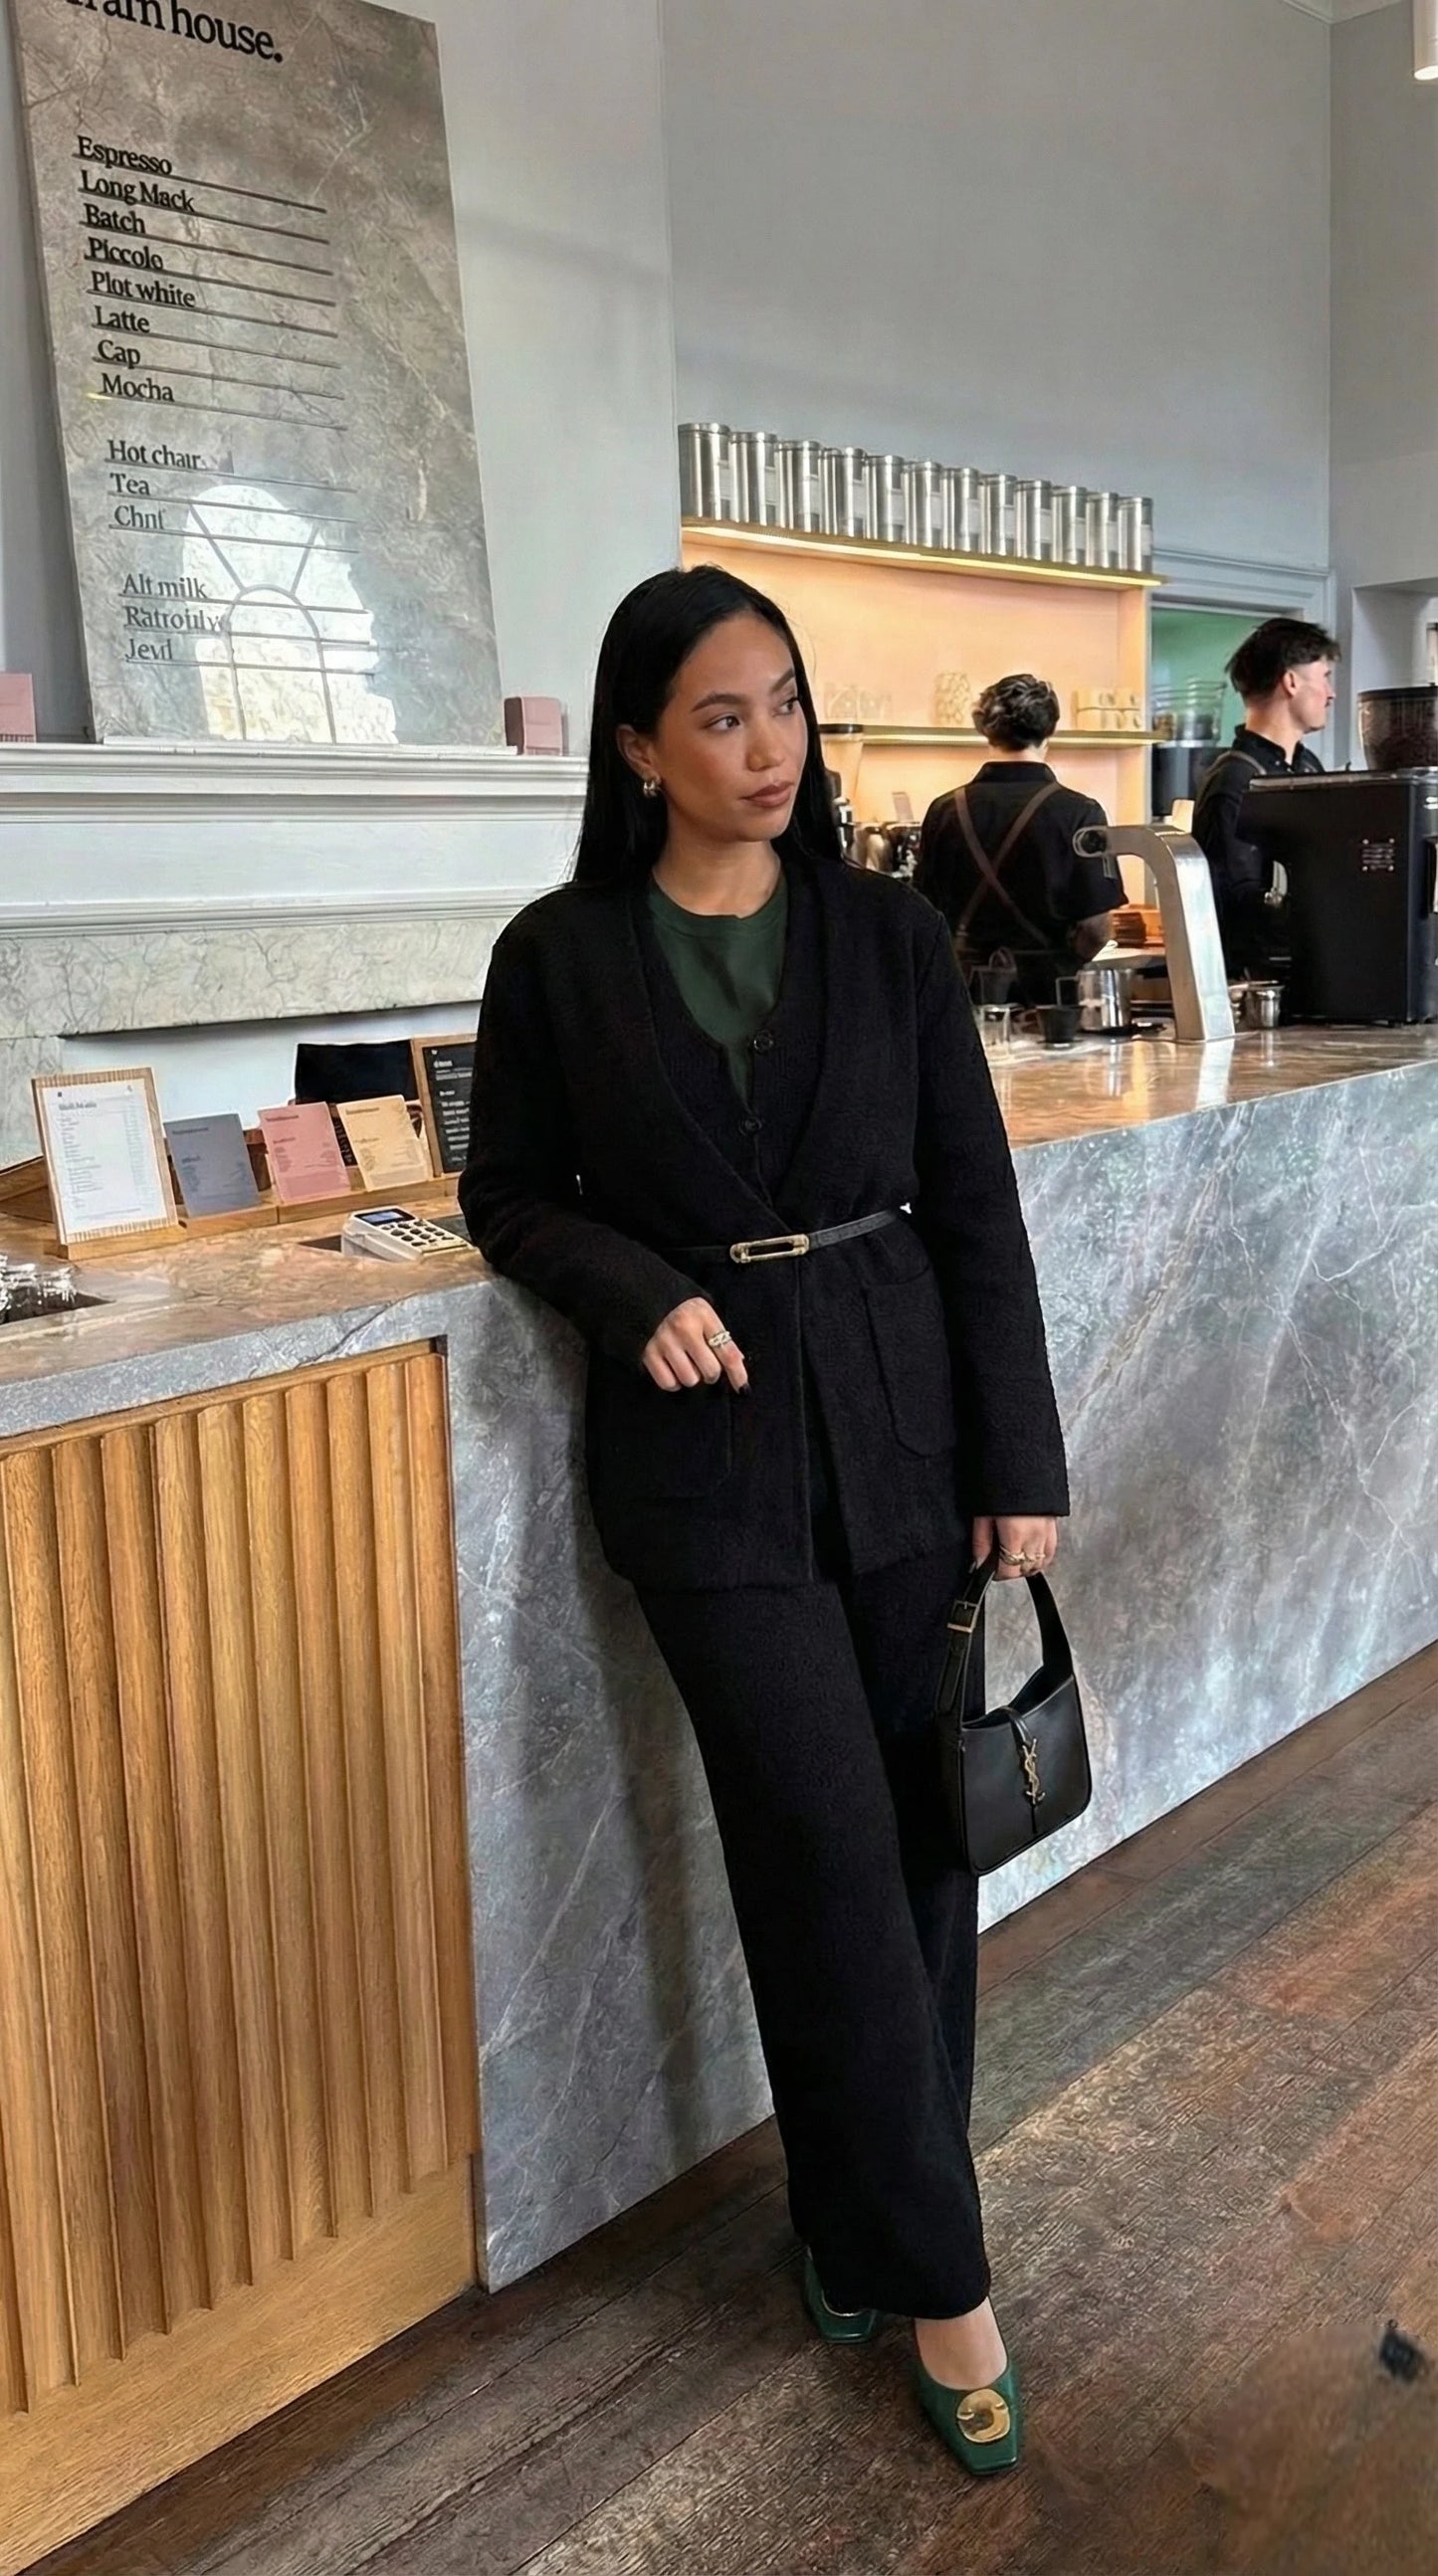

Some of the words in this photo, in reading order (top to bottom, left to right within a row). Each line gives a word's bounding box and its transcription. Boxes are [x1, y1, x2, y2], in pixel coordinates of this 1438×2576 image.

[77, 134, 173, 176] Espresso
[81, 168, 136, 206] Long
[139, 181, 196, 214] Mack
[83, 202, 146, 235] Batch
[88, 236, 164, 271] Piccolo
[92, 270, 133, 298] Plot
[135, 281, 197, 308] white
[95, 304, 150, 334] Latte
[98, 339, 141, 370] Cap
[101, 372, 175, 403] Mocha
[107, 439, 148, 465] Hot
[109, 472, 150, 496] Tea
[122, 573, 153, 596] Alt
[157, 577, 208, 599] milk
